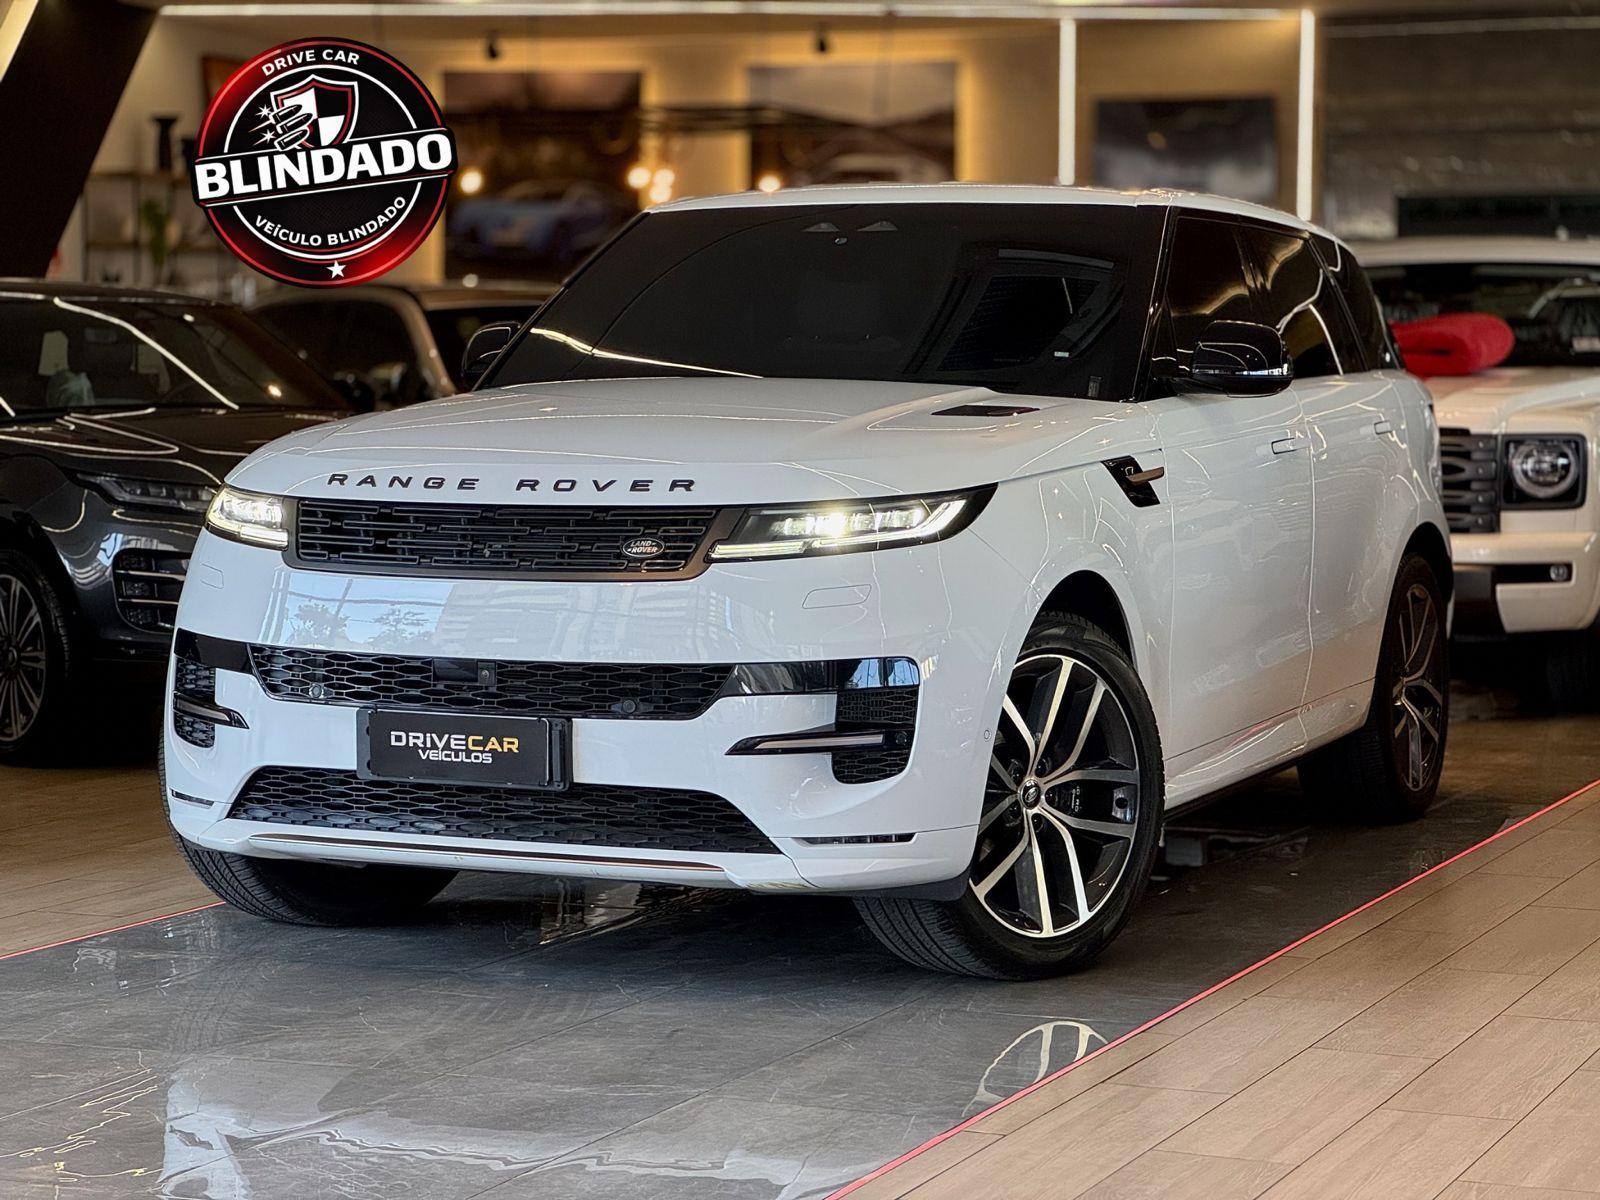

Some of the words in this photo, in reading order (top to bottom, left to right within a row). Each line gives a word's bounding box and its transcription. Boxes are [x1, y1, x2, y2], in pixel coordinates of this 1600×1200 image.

[327, 473, 480, 491] RANGE
[516, 479, 696, 493] ROVER
[631, 546, 658, 554] ROVER
